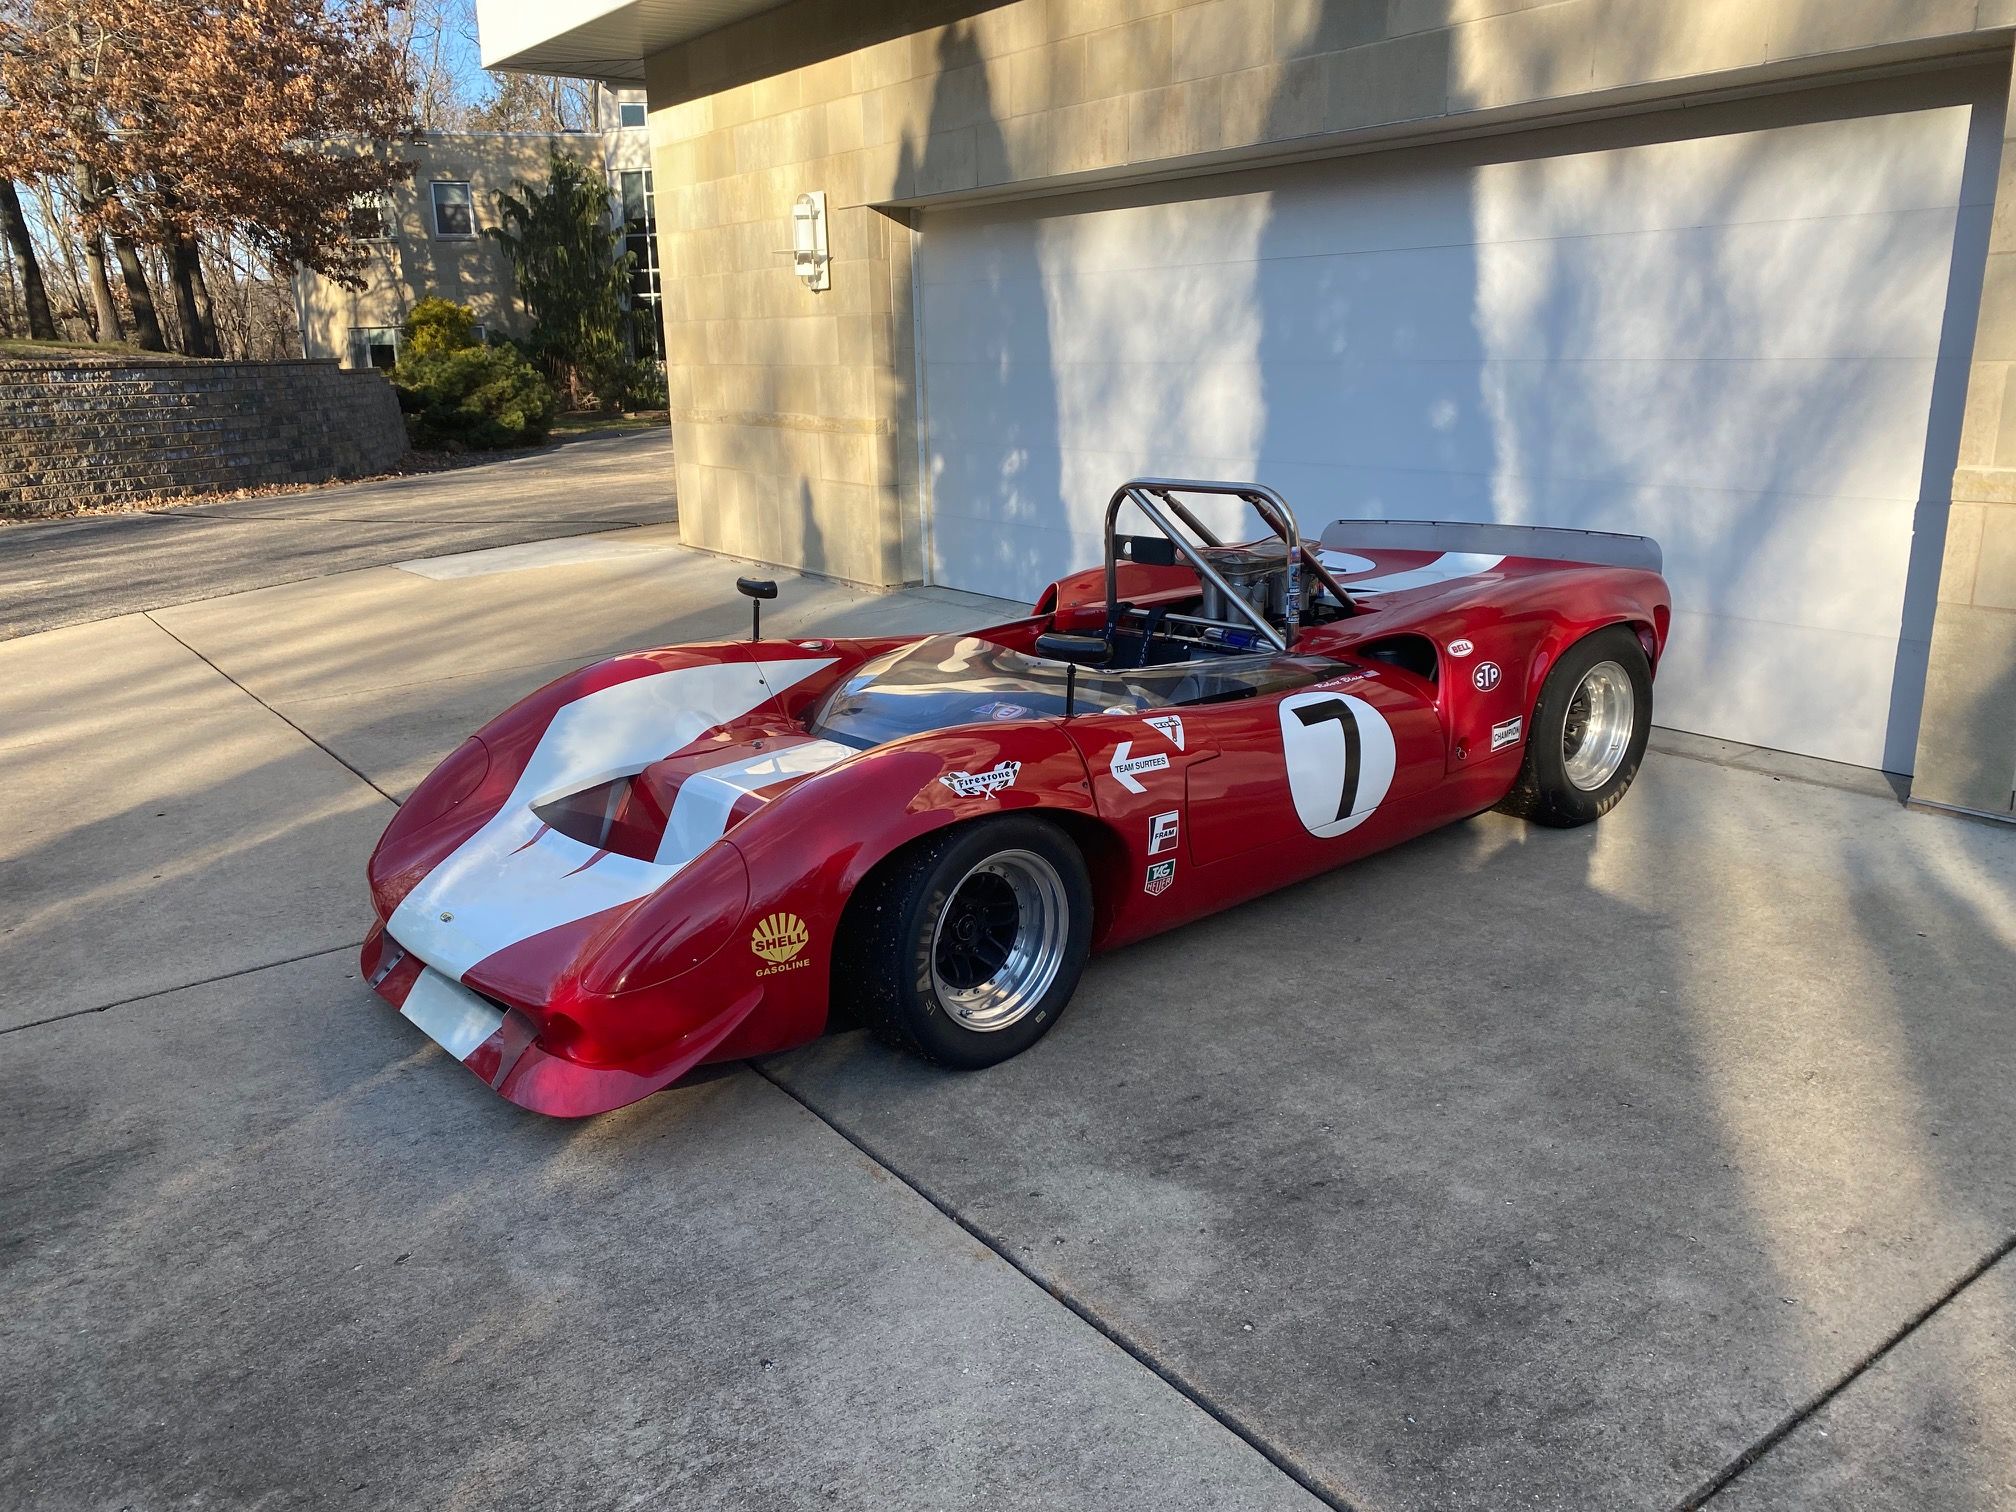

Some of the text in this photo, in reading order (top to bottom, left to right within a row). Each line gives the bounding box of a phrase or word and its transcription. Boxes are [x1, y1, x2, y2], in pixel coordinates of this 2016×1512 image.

[1452, 643, 1471, 654] BELL
[1476, 664, 1498, 687] STP
[1494, 726, 1520, 742] CHAMPION
[1115, 757, 1166, 773] TEAM SURTEES
[1291, 699, 1361, 821] 7
[957, 770, 1011, 789] Firestone
[1155, 828, 1175, 839] FRAM
[1152, 863, 1170, 880] TAG
[1147, 877, 1171, 893] HEUER
[755, 932, 806, 952] SHELL
[755, 958, 811, 977] GASOLINE
